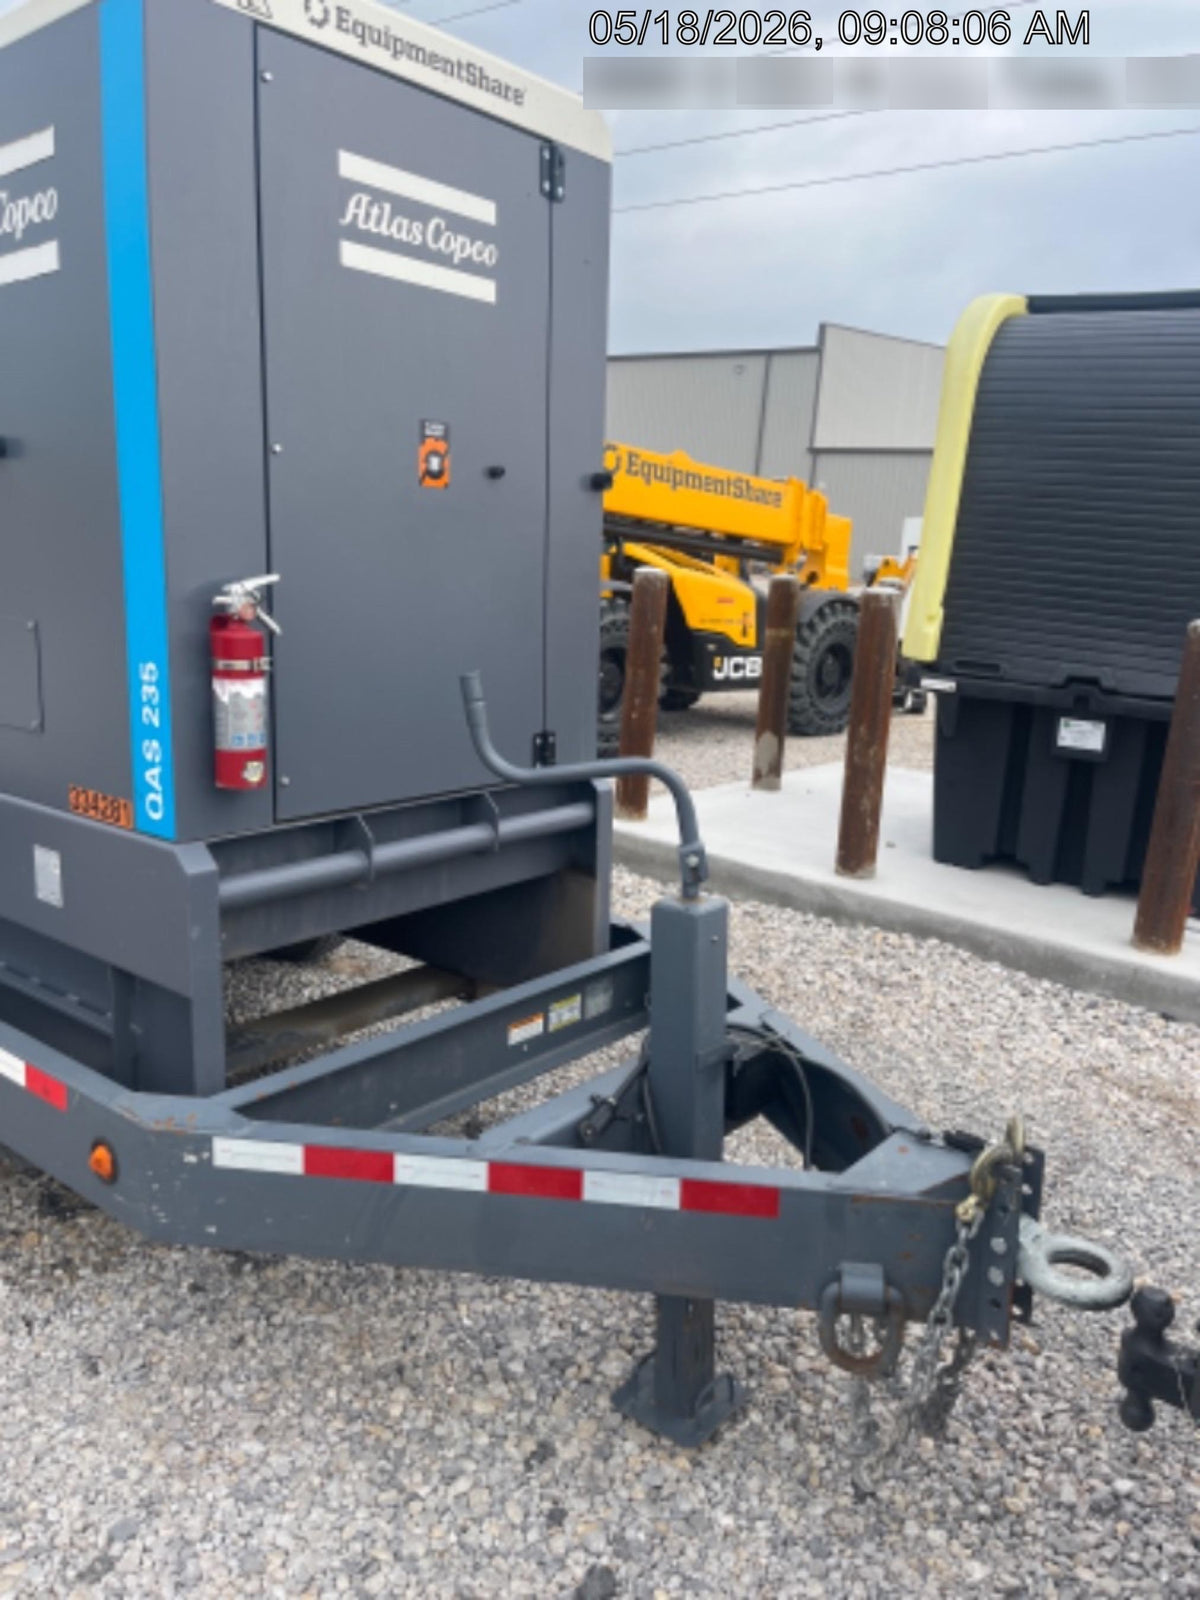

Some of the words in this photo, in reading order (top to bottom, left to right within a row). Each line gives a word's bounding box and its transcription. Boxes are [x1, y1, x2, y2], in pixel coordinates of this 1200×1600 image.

[335, 6, 526, 106] EquipmentShare
[339, 193, 424, 245] Atlas
[426, 216, 498, 267] Copco
[626, 452, 782, 508] EquipmentShare
[138, 660, 161, 728] 235
[713, 656, 763, 680] JCB
[141, 739, 164, 821] QAS
